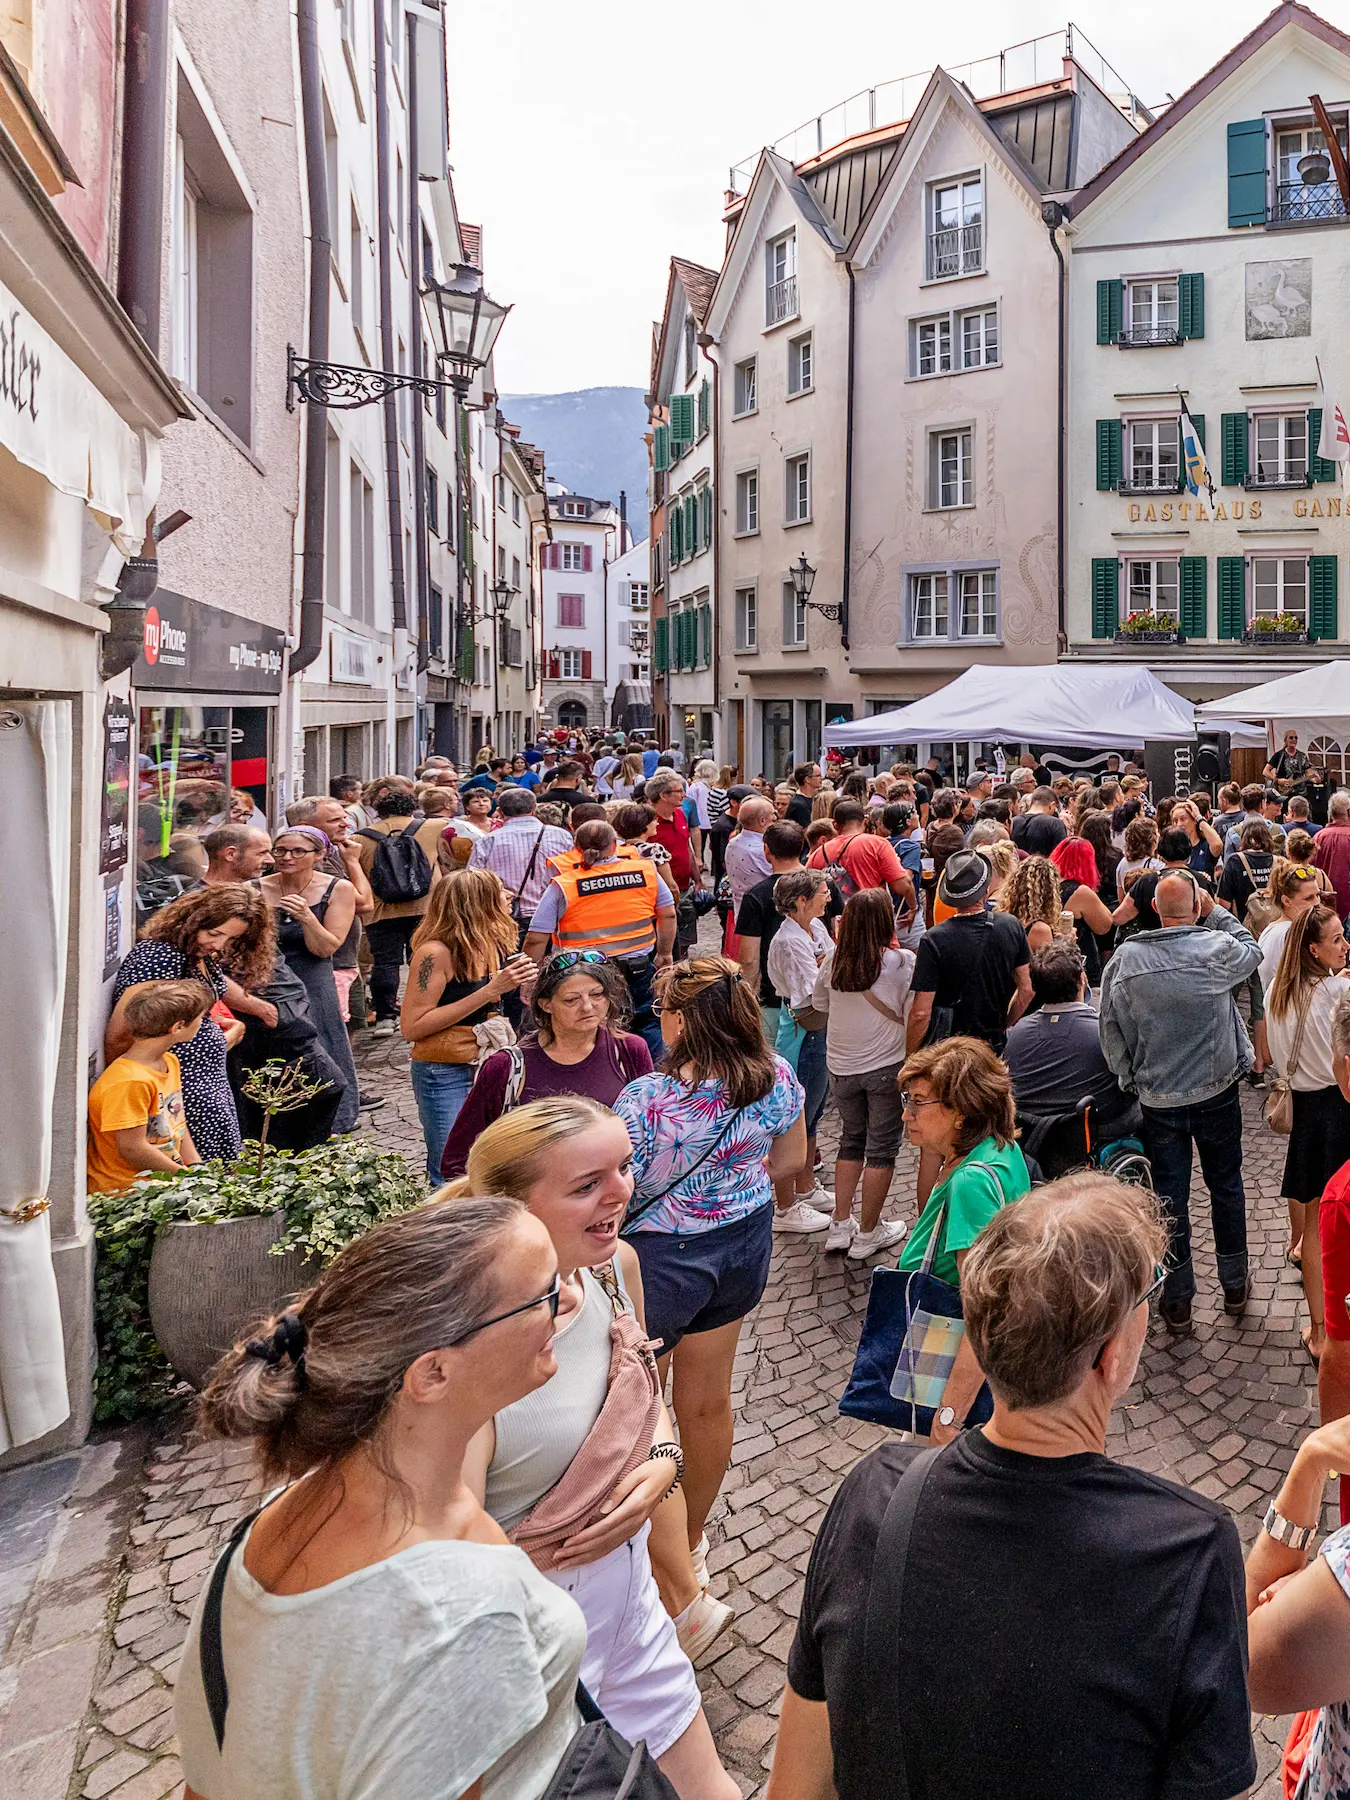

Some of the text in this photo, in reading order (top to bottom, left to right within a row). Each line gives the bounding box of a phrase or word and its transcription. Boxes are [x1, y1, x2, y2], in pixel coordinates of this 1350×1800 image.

[1127, 500, 1262, 522] GASTHAUS
[146, 620, 186, 655] my Phone
[581, 873, 643, 892] SECURITAS
